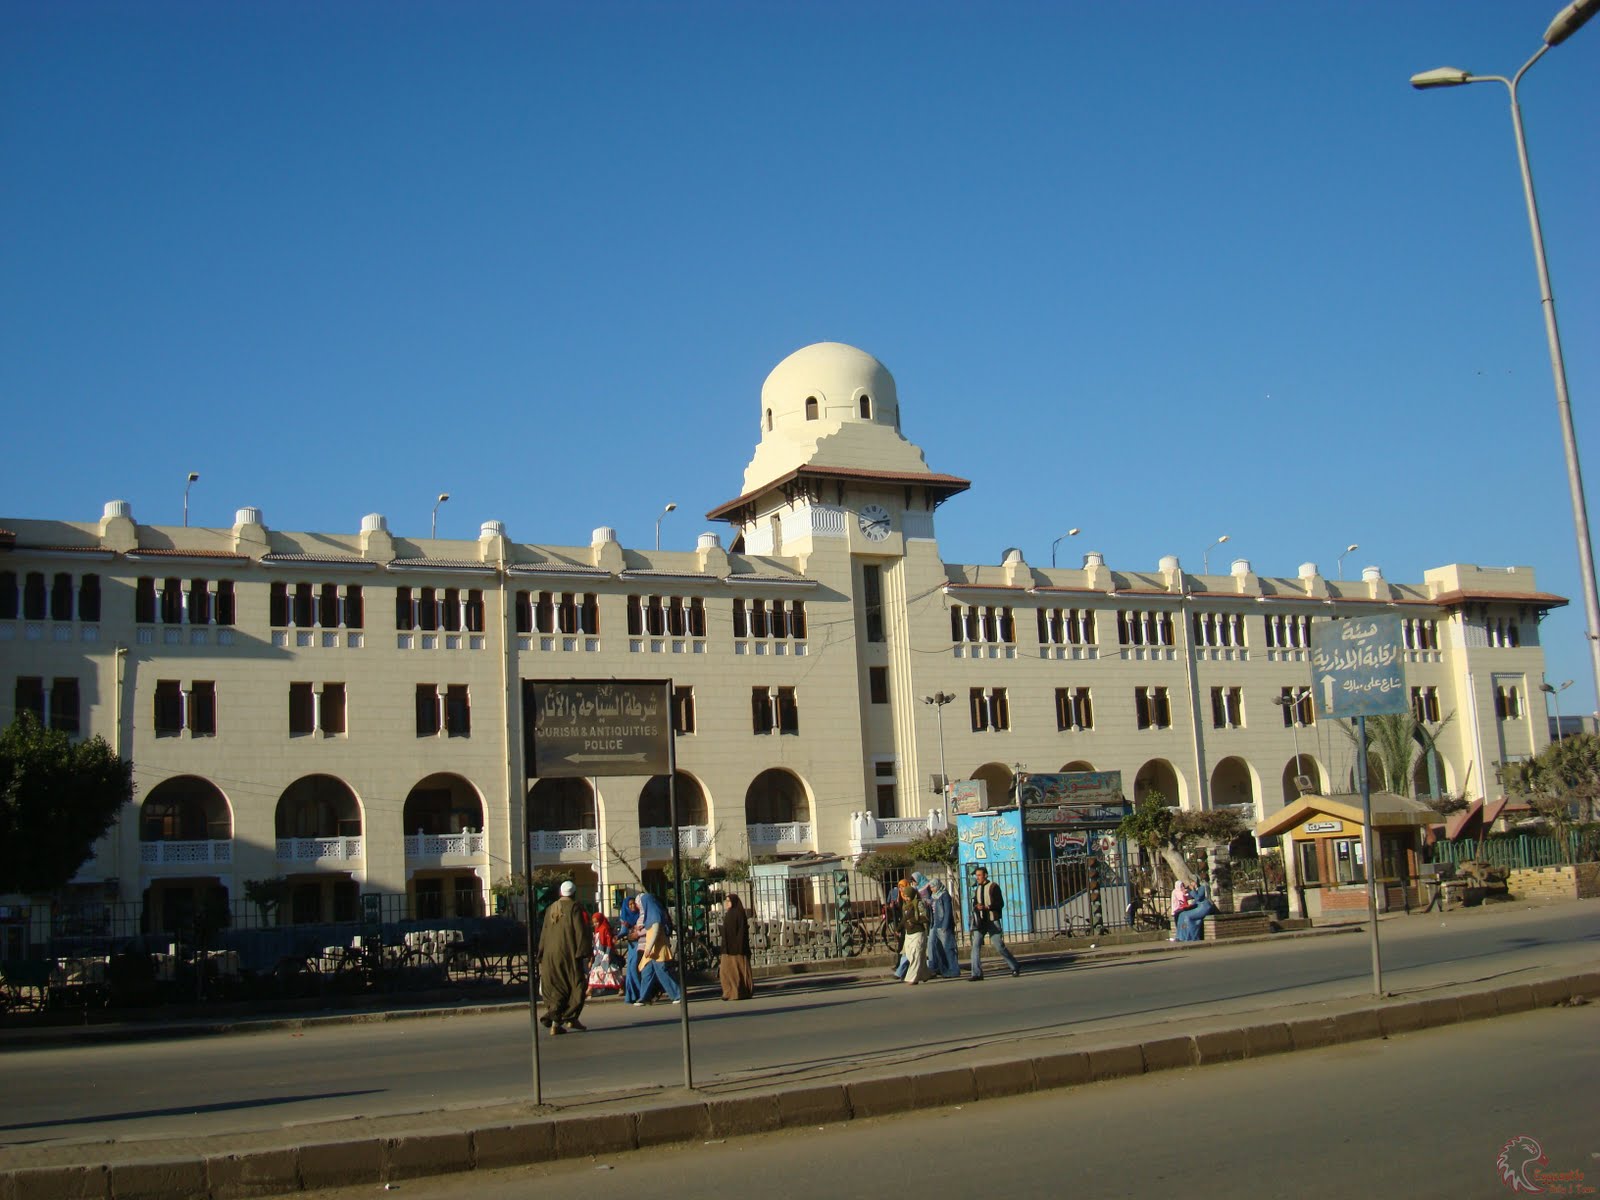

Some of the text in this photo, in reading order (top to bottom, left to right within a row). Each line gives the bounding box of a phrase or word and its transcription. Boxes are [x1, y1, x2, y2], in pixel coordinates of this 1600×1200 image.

[1363, 643, 1399, 668] لرقابة
[624, 690, 657, 722] شرطة
[537, 726, 579, 737] OURISM
[589, 725, 658, 737] ANTIQUITIES
[585, 739, 624, 750] POLICE
